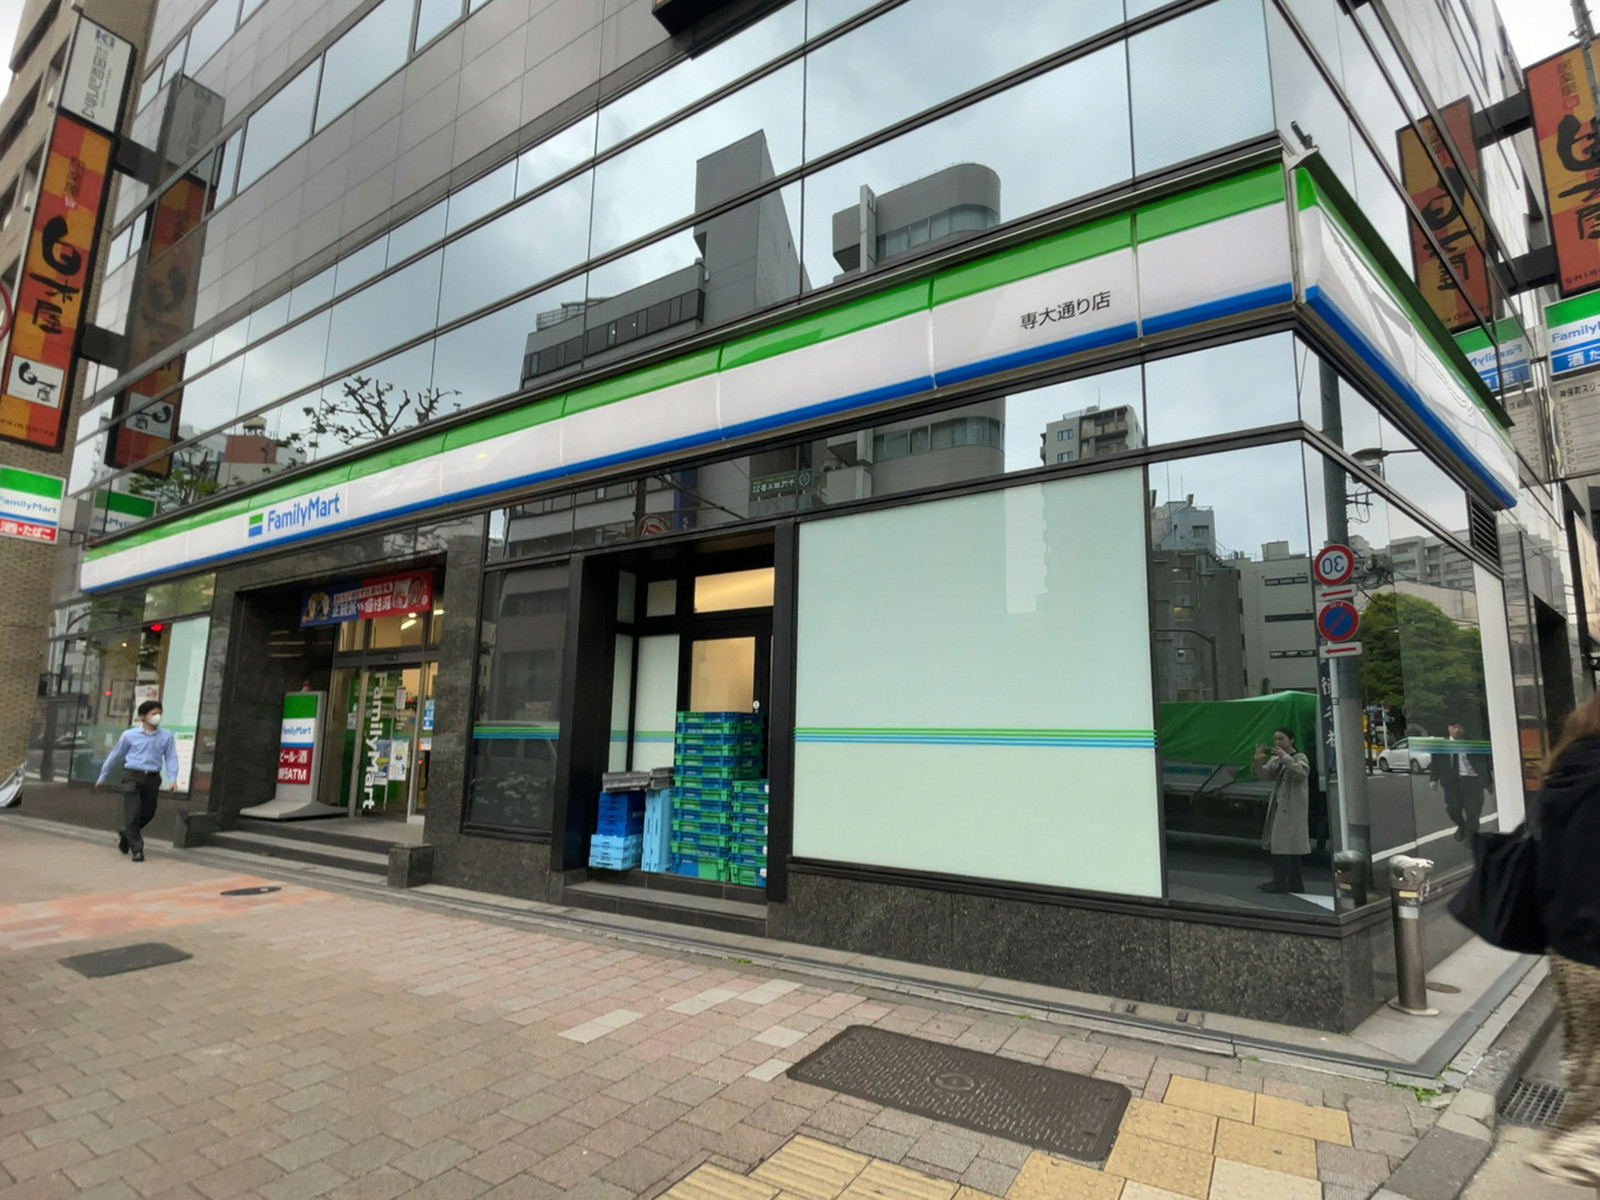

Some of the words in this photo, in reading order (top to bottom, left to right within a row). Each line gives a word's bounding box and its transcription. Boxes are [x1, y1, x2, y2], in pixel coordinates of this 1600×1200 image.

[1020, 290, 1111, 330] 専大通り店
[1552, 320, 1600, 343] Family
[267, 492, 340, 531] FamilyMart
[362, 671, 388, 811] FamilyMart
